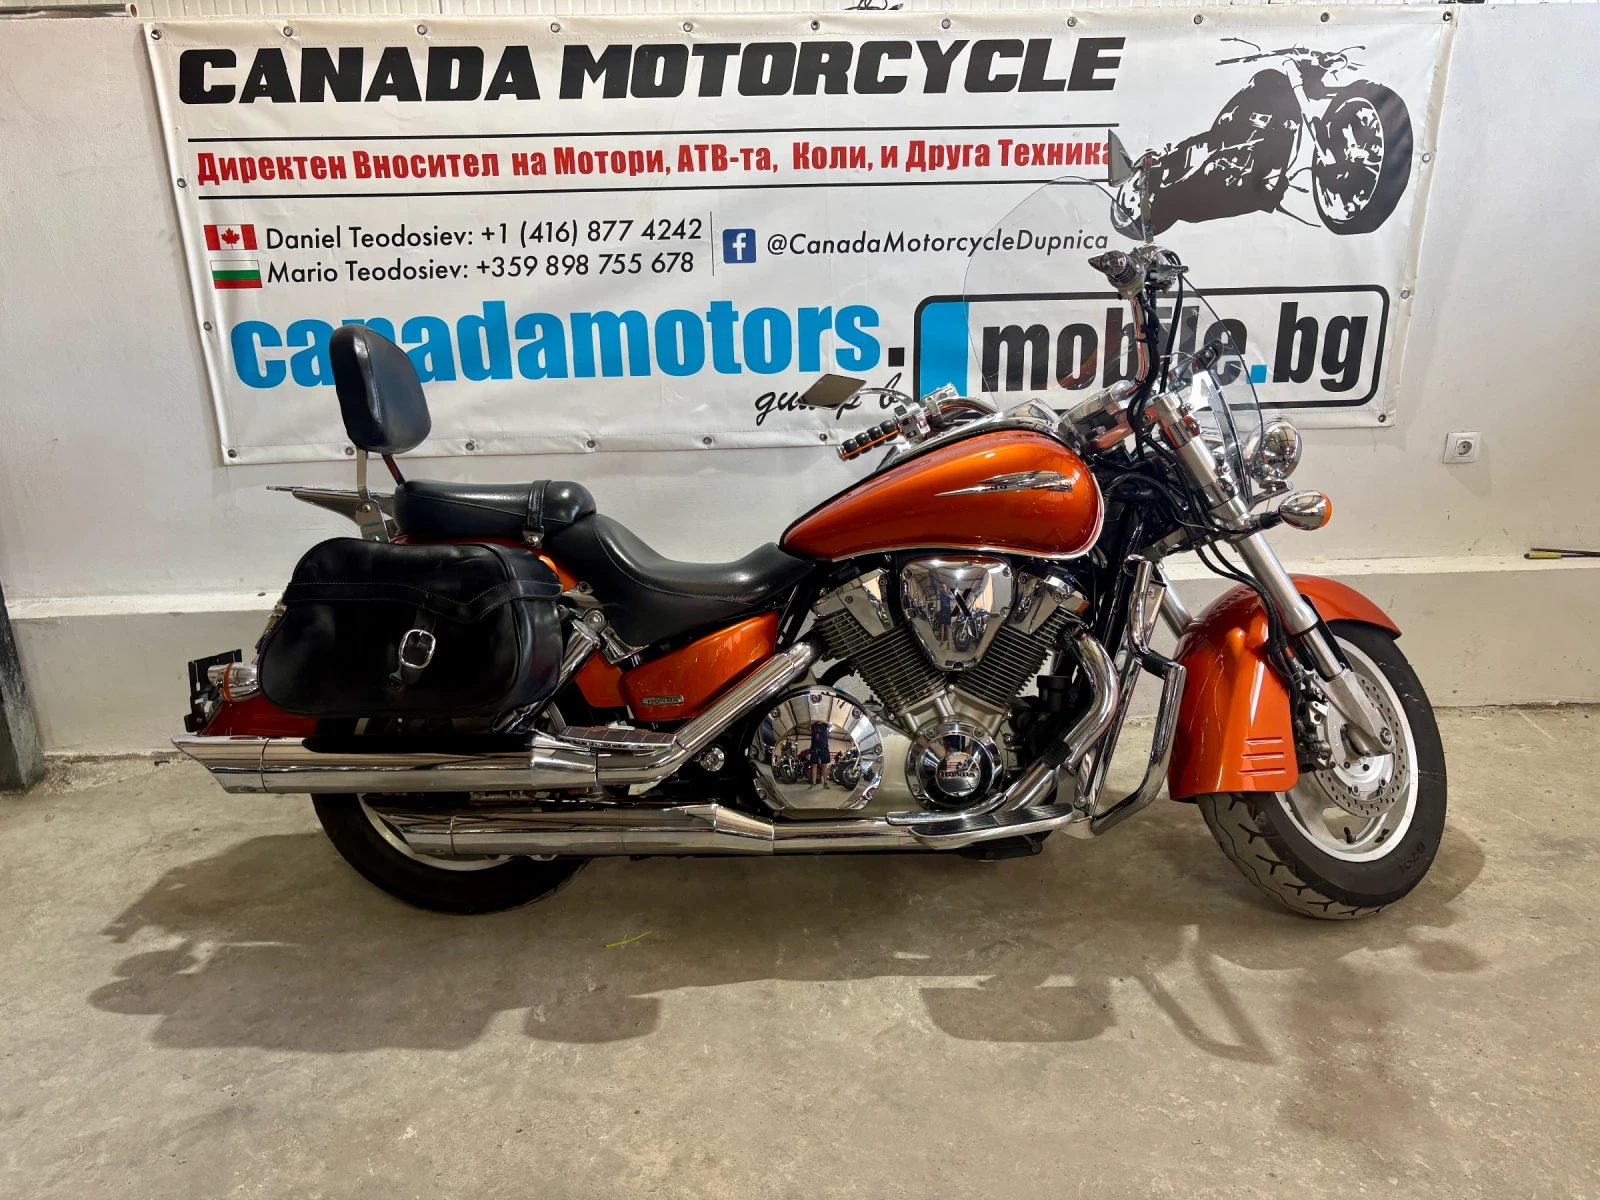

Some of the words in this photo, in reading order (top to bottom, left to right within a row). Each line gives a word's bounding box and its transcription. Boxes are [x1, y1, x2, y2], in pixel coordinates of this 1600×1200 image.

[178, 45, 541, 104] CANADA
[559, 37, 1124, 99] MOTORCYCLE
[197, 152, 347, 186] Директен
[352, 150, 500, 180] Вносител
[511, 152, 547, 176] на
[553, 146, 671, 177] Мотори,
[677, 143, 779, 173] АТВ-та,
[792, 142, 873, 171] Коли,
[880, 145, 898, 169] и
[905, 140, 990, 172] Друга
[266, 225, 341, 249] Daniel
[348, 223, 473, 248] Teodosiev:
[481, 223, 507, 244] +1
[520, 219, 578, 248] (416)
[587, 220, 634, 242] 877
[640, 218, 702, 241] 4242
[766, 229, 1109, 258] @CanadaMotorcycleDupnica
[267, 261, 338, 283] Mario
[345, 258, 468, 281] Teodosiev:
[476, 255, 538, 277] +359
[545, 254, 589, 276] 898
[598, 253, 642, 275] 755
[651, 251, 694, 273] 678
[939, 771, 976, 779] HONDA
